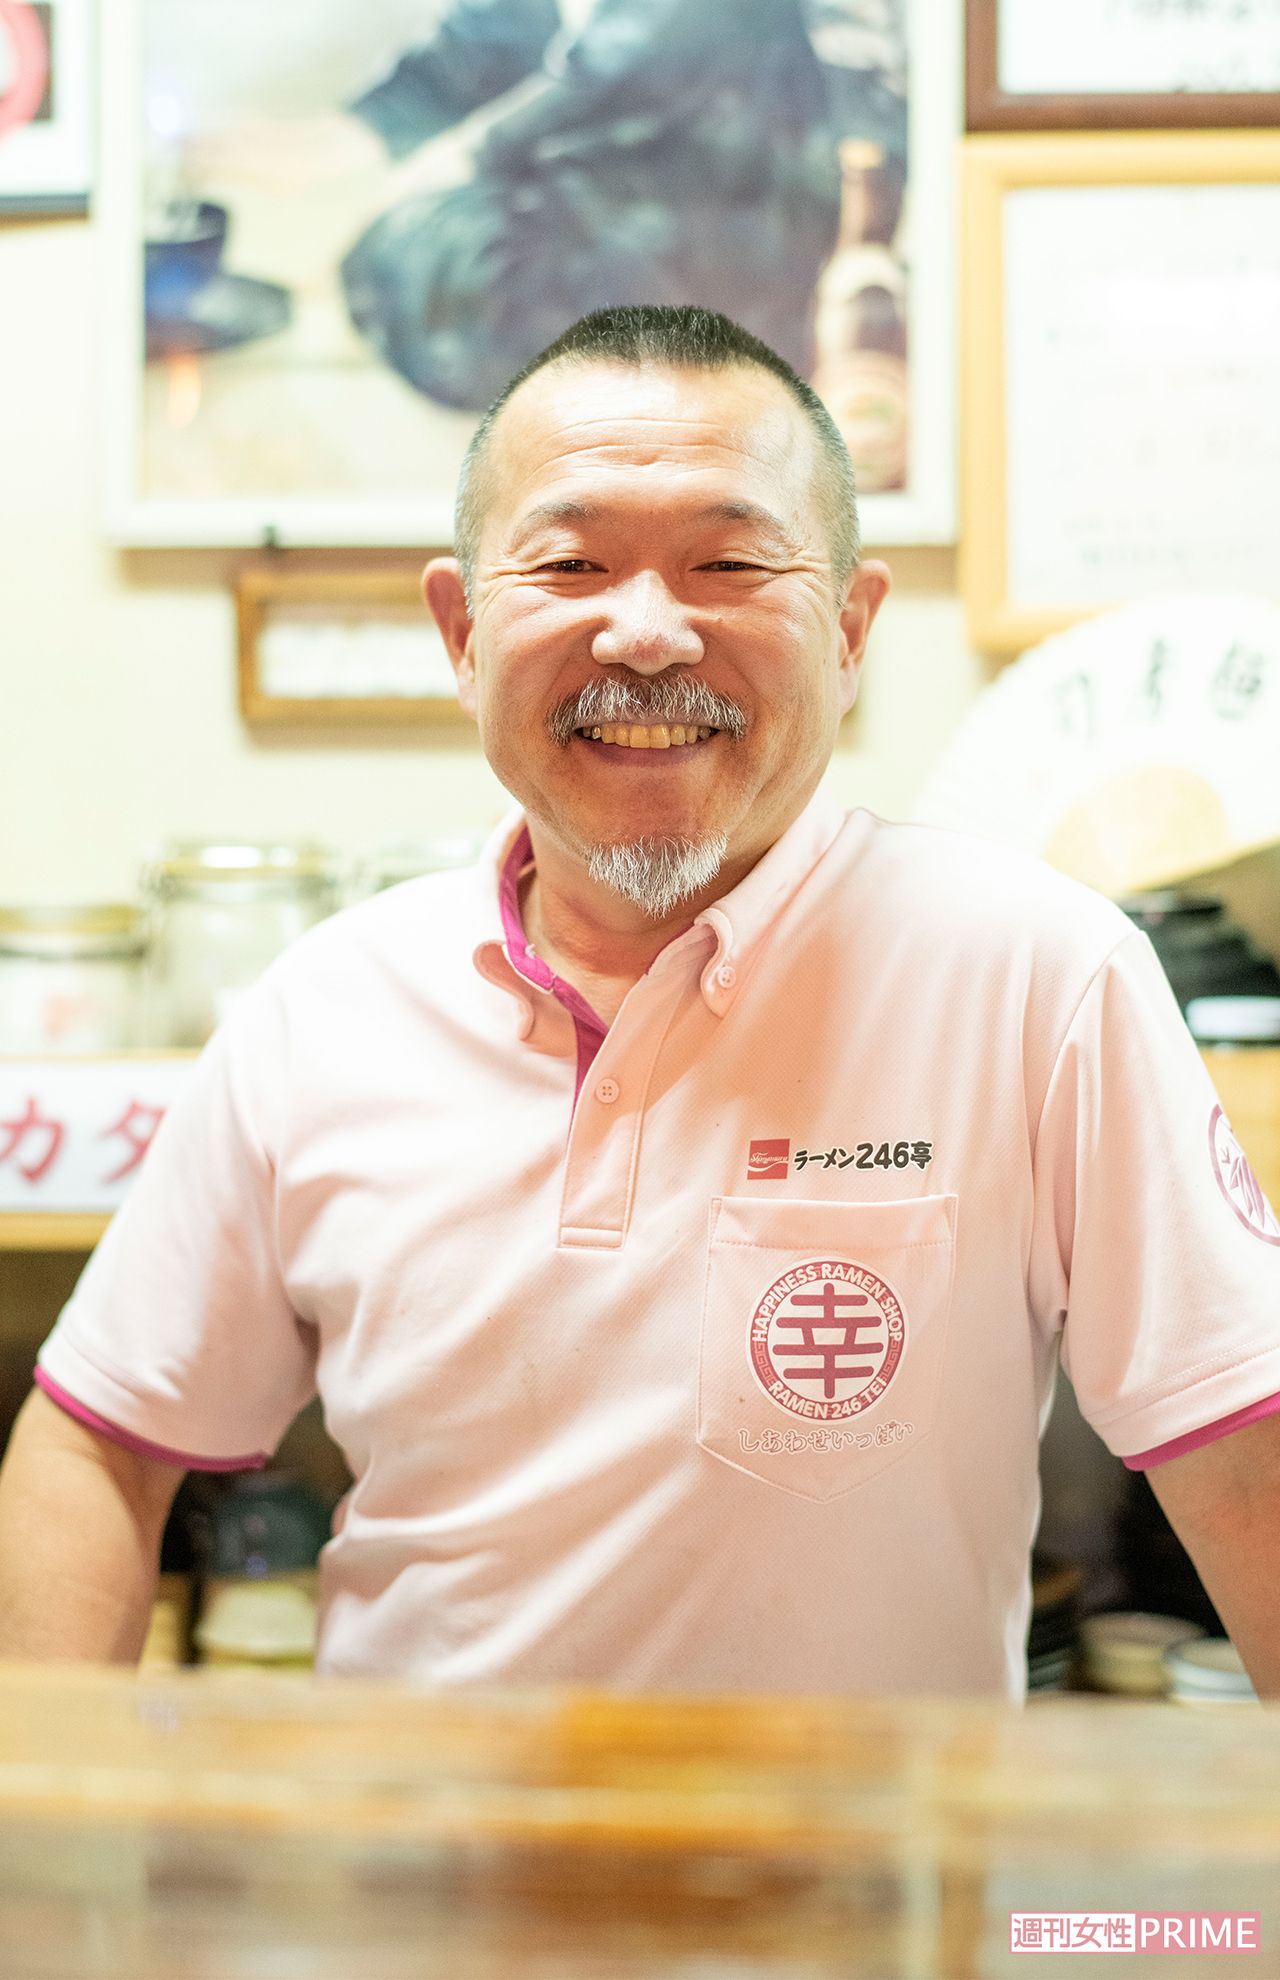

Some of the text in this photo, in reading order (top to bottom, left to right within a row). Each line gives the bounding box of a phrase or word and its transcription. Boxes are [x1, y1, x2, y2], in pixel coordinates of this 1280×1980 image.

[794, 1141, 932, 1170] ラーメン246亭
[752, 1263, 904, 1342] HAPPINESS RAMEN SHOP
[772, 1282, 884, 1399] 幸
[768, 1376, 888, 1419] RAMEN 246 TEI
[739, 1421, 914, 1454] しあわせいっぱい
